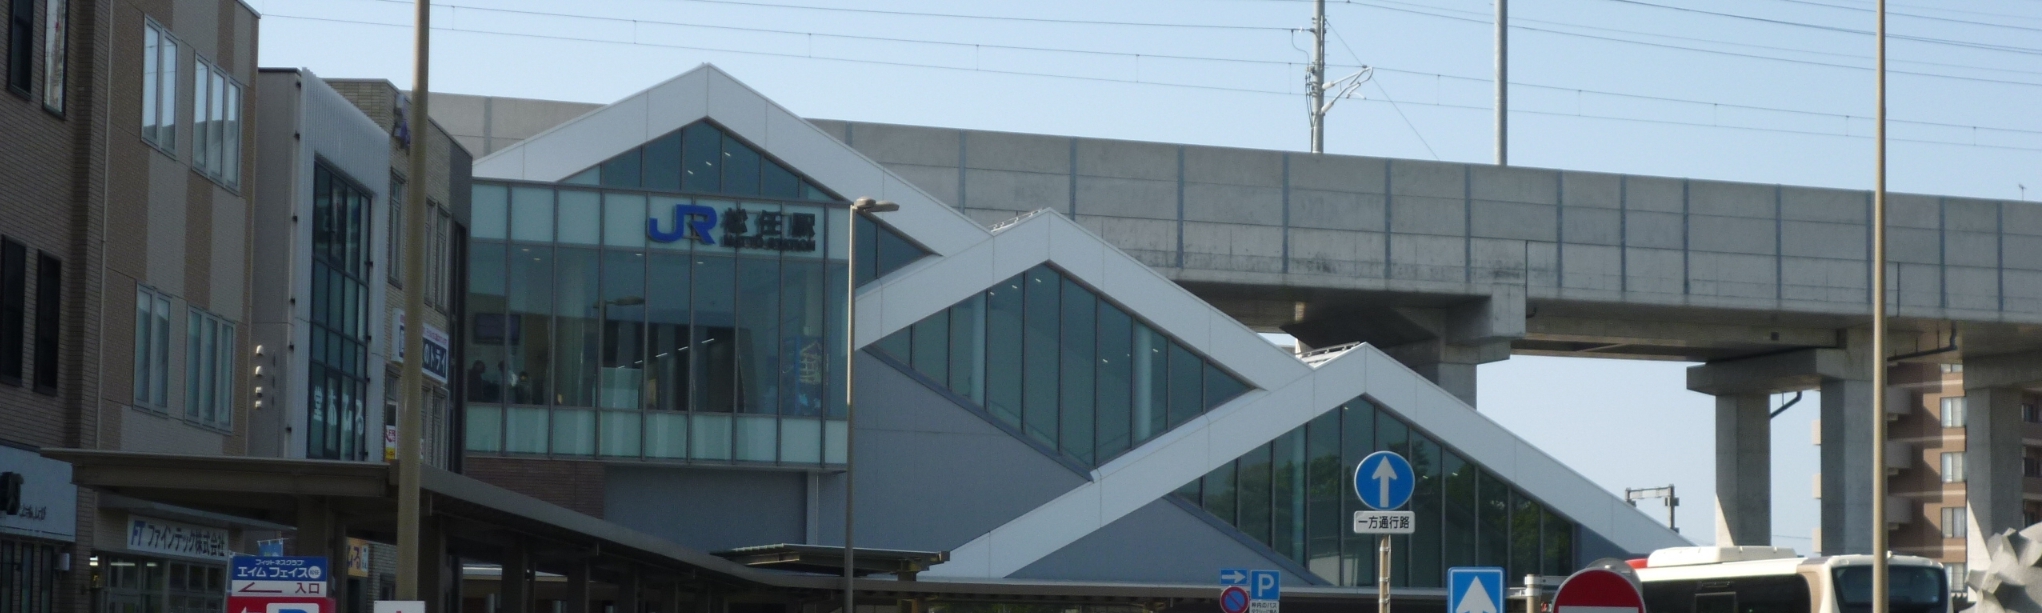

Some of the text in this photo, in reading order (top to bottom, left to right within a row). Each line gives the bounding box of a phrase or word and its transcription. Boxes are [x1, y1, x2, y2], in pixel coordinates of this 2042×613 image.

[650, 204, 717, 244] JR
[1358, 516, 1410, 529] 一方通行路
[131, 521, 225, 556] FT ファインテック株式会社
[237, 566, 267, 577] エイム
[269, 567, 308, 578] フェイス
[295, 582, 320, 594] 入口
[1258, 574, 1274, 597] P
